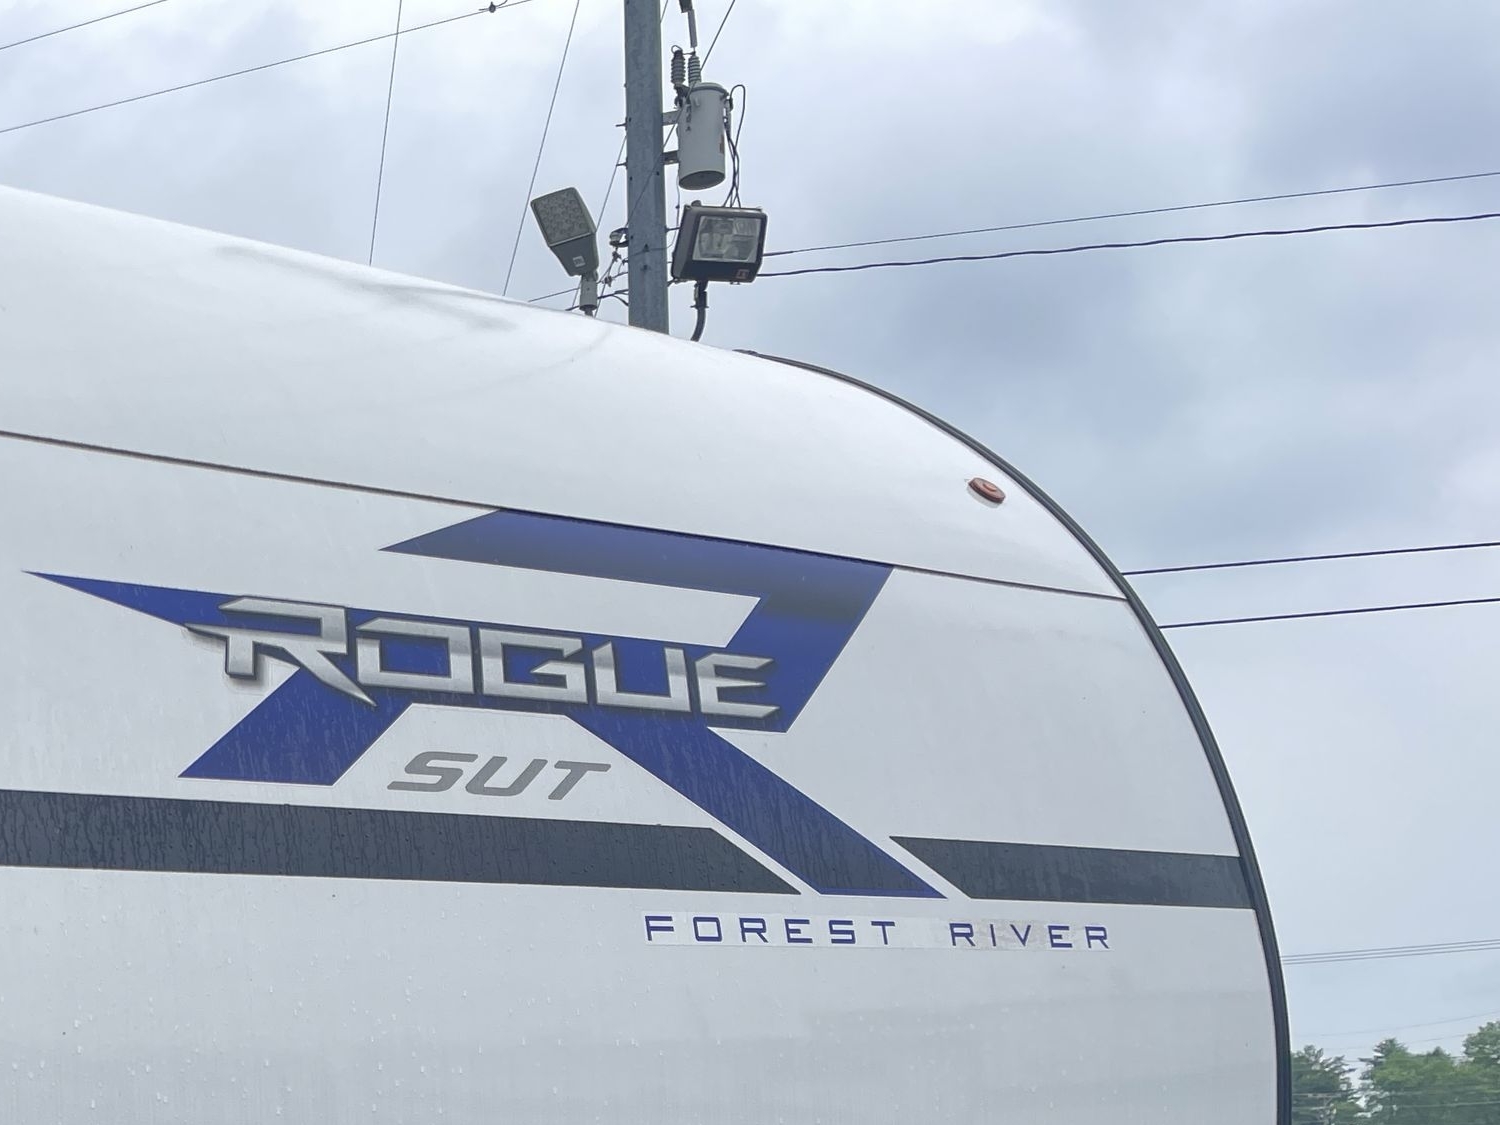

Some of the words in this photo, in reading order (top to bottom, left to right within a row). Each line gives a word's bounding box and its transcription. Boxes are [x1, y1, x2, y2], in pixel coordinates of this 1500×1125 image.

[184, 596, 782, 719] ROGUE
[386, 750, 612, 801] SUT
[644, 915, 896, 946] FOREST
[949, 922, 1110, 950] RIVER
